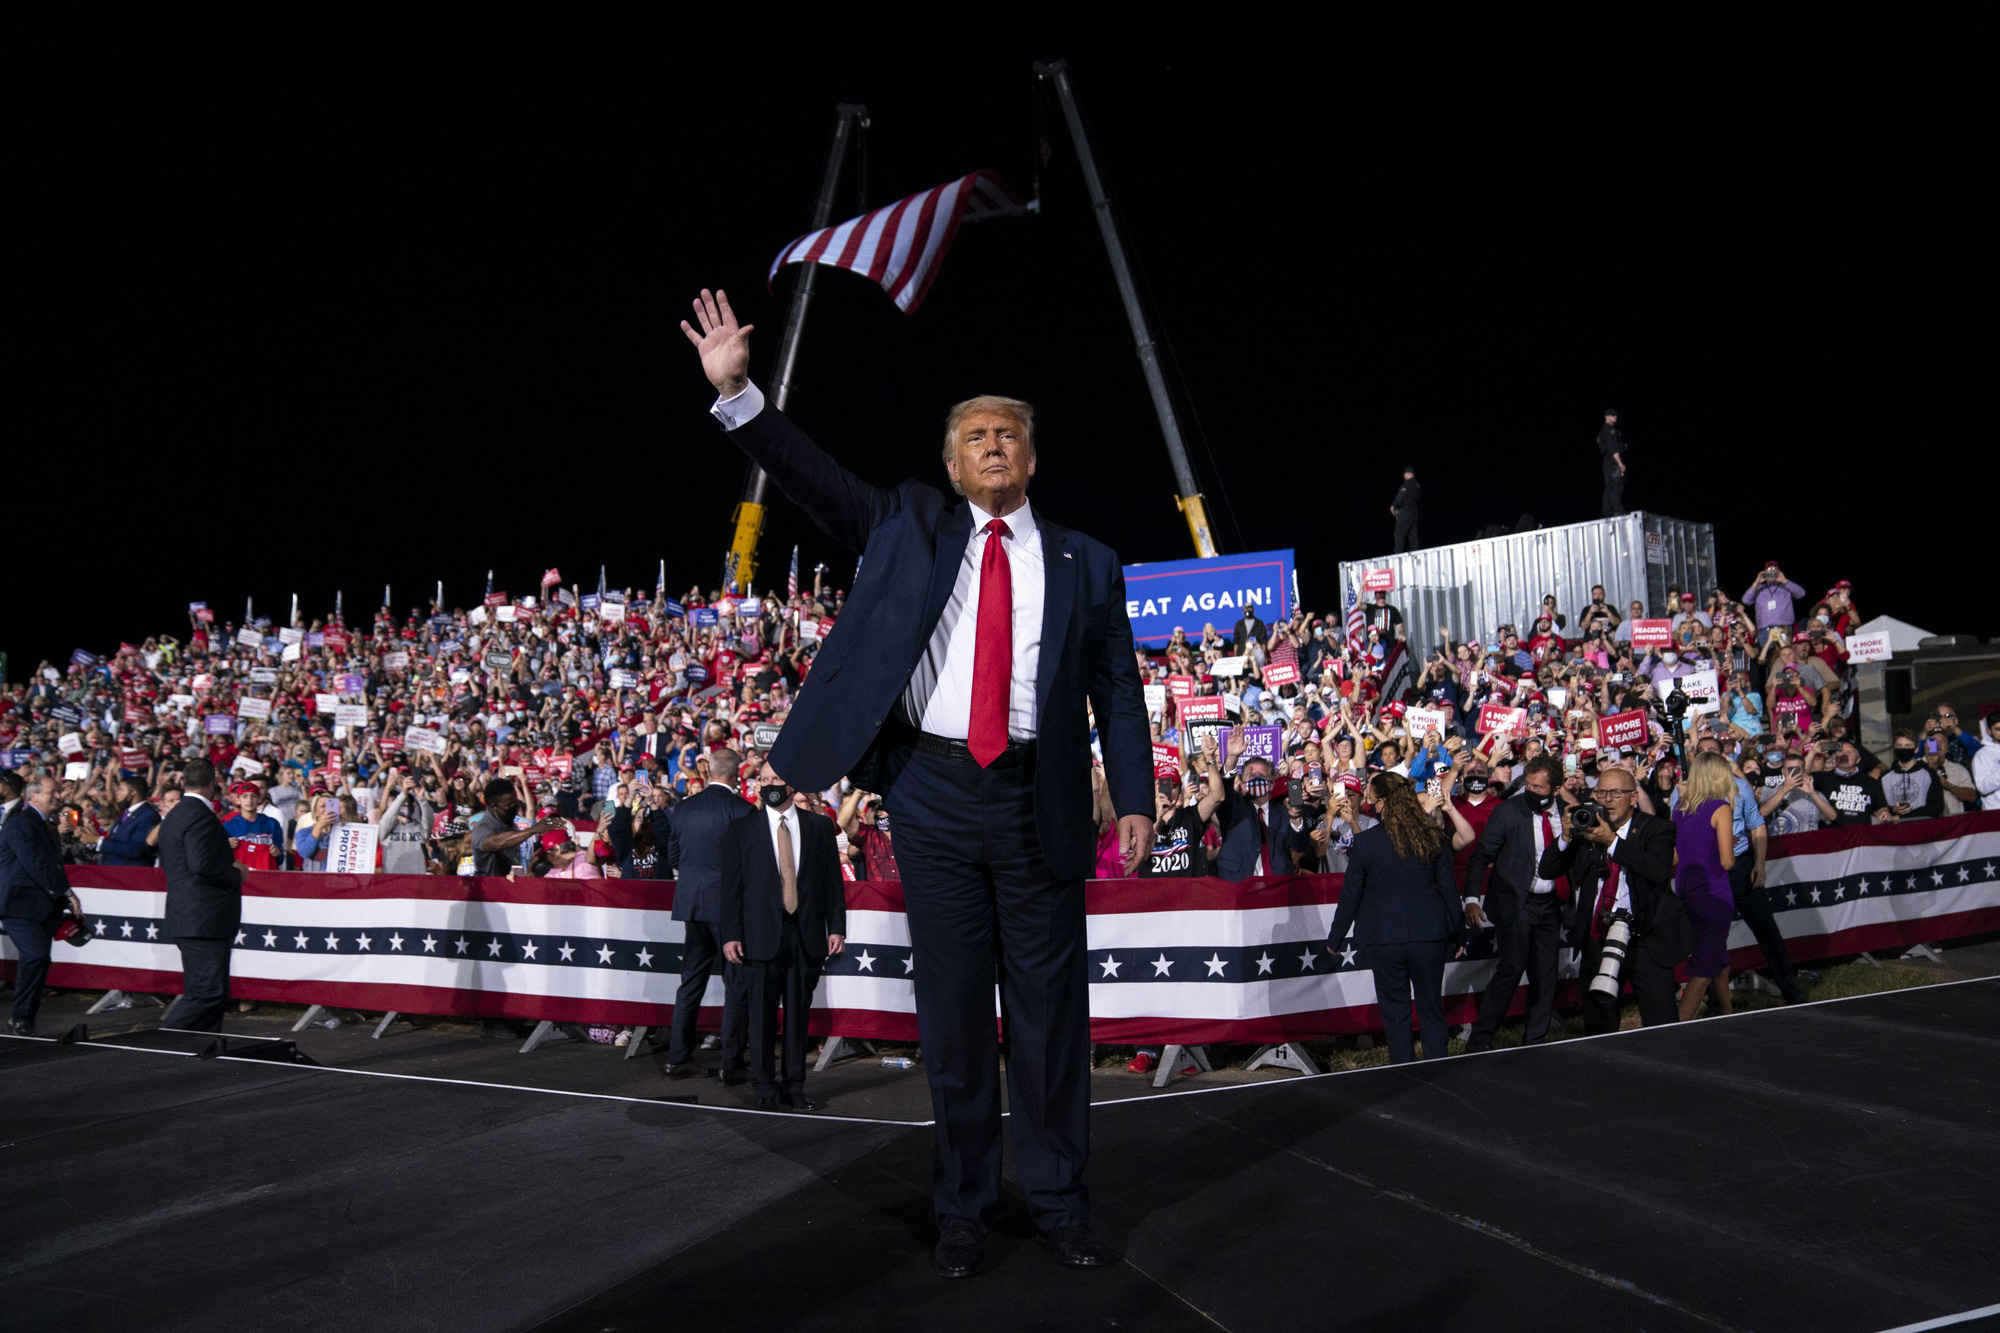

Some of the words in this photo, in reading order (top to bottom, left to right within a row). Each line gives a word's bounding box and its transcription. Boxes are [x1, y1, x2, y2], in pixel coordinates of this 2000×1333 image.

[1126, 597, 1172, 618] EAT
[1181, 587, 1272, 613] AGAIN!
[1860, 639, 1883, 647] MORE
[1854, 647, 1884, 656] YEARS!
[1272, 665, 1293, 674] MORE
[1269, 671, 1294, 682] YEARS!
[1172, 687, 1190, 695] EARS!
[1183, 705, 1190, 714] 4
[1191, 704, 1219, 713] MORE
[1417, 716, 1440, 724] MORE
[1485, 711, 1492, 719] 4
[1493, 712, 1520, 723] MORE
[1486, 720, 1517, 730] YEARS!
[1606, 725, 1613, 734] 4
[1614, 718, 1641, 732] MORE
[1244, 733, 1272, 746] O-LIFE
[1608, 729, 1642, 744] YEARS!
[1153, 753, 1179, 765] ERICA
[1839, 784, 1864, 794] KEEP
[1829, 790, 1872, 805] AMERICA
[1835, 800, 1868, 812] GREAT
[348, 829, 359, 873] PEACEFU
[1151, 851, 1190, 873] 2020
